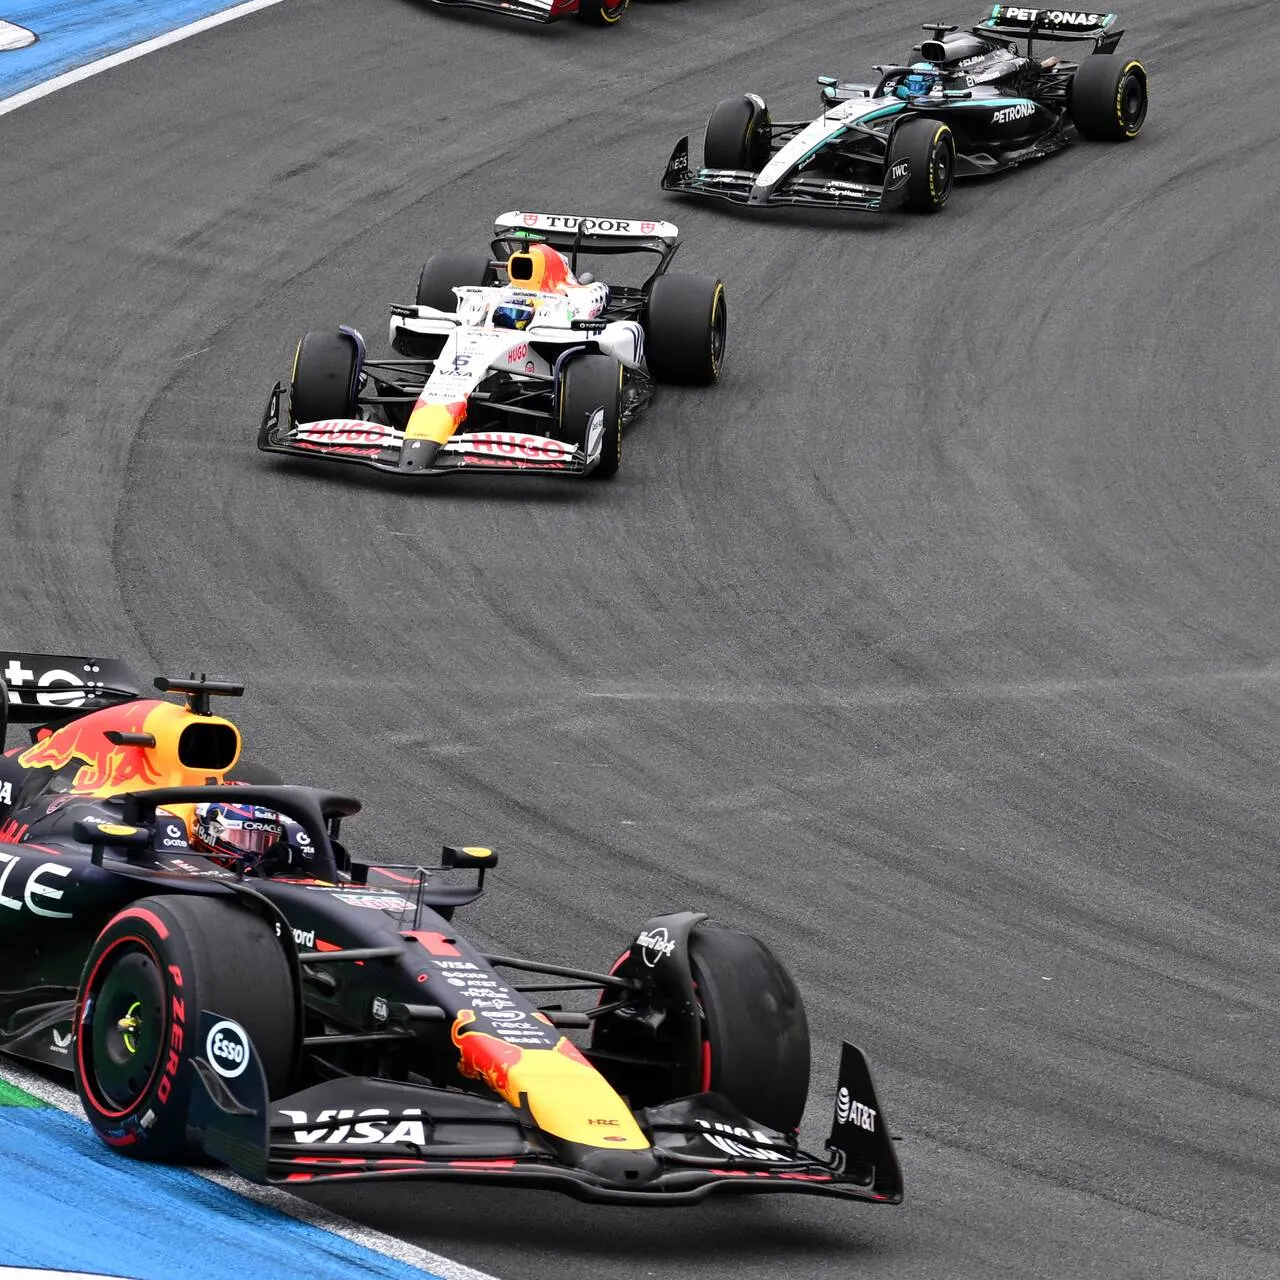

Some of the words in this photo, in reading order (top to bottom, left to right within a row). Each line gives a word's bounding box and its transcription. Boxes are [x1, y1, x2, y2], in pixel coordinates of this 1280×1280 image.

[1006, 7, 1099, 26] PETONAS
[992, 103, 1037, 125] PETRONAS
[892, 164, 908, 179] IWC
[547, 215, 631, 233] TUDOR
[507, 344, 529, 364] HUGO
[440, 370, 473, 378] VISA
[306, 421, 385, 442] HUGO
[471, 433, 565, 459] HUGO
[163, 838, 187, 847] Gate
[431, 960, 479, 970] VISA
[169, 964, 185, 988] P
[157, 995, 186, 1105] ZERO
[213, 1033, 244, 1063] Esso
[279, 1108, 426, 1145] VISA
[848, 1102, 876, 1133] AT&T
[695, 1119, 793, 1161] VISA
